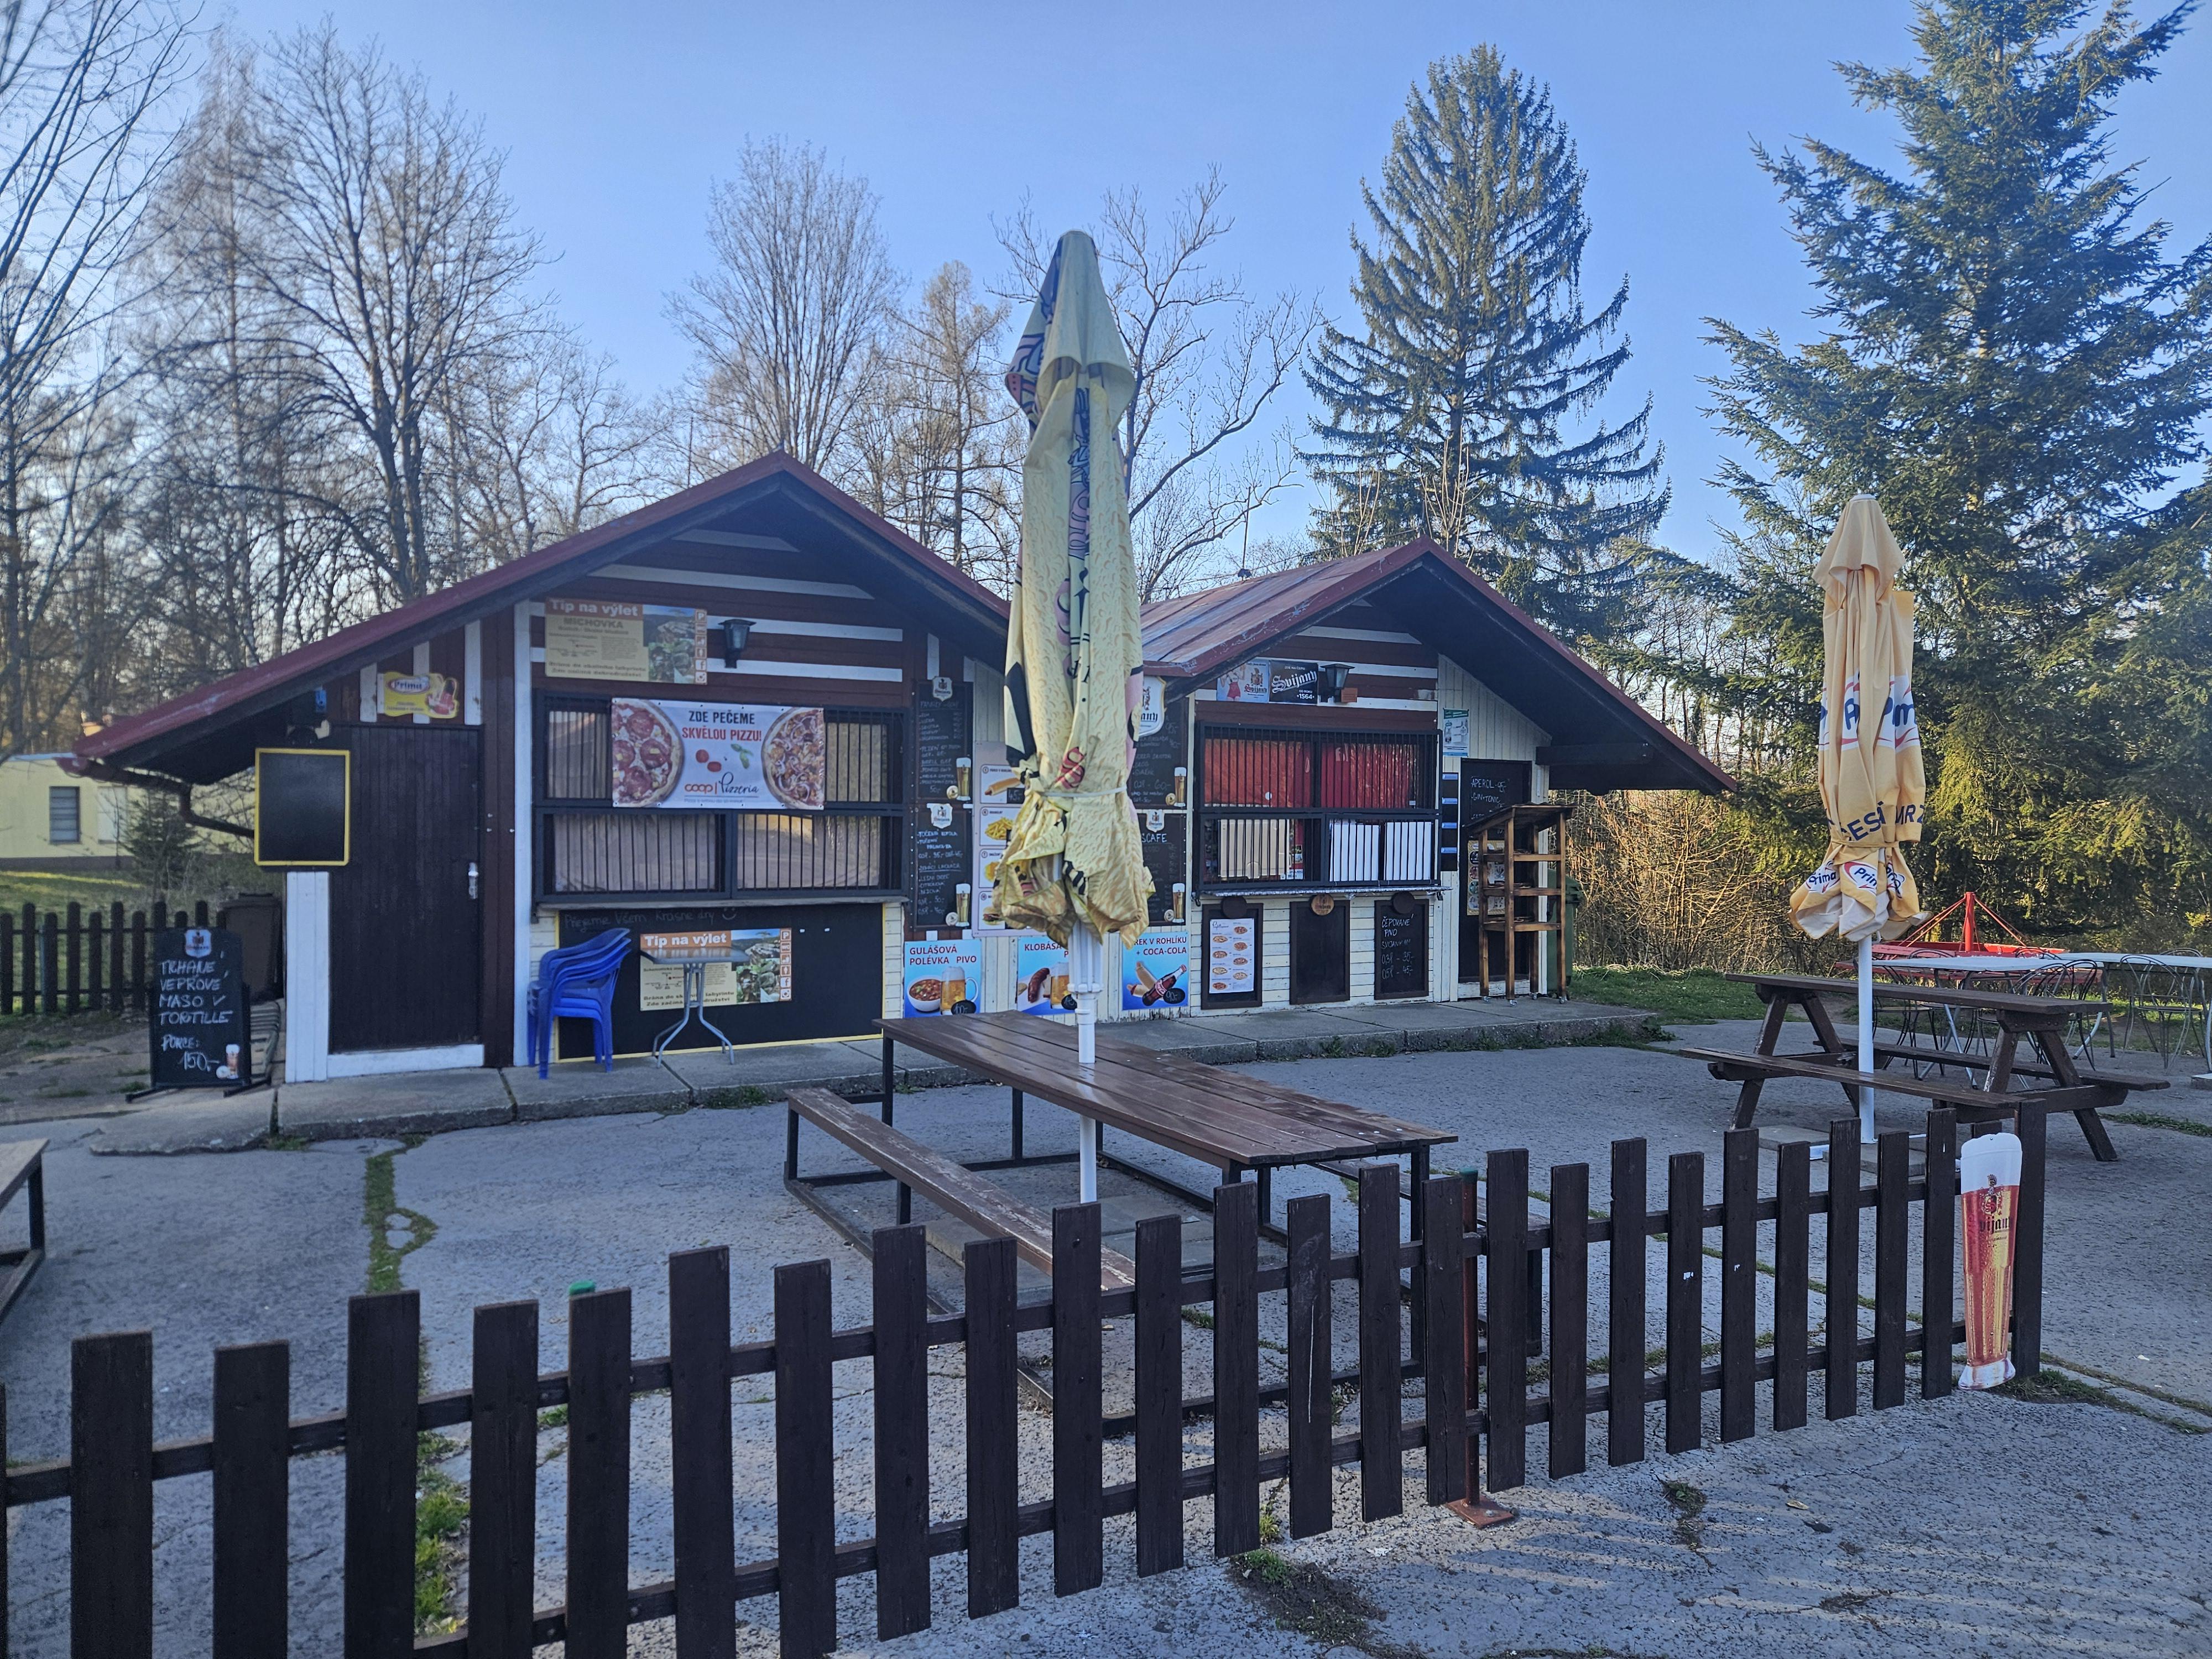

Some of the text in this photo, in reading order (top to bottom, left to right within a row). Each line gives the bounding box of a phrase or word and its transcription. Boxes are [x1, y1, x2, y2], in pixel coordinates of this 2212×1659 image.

[549, 599, 638, 617] Tip na výlet
[1271, 670, 1317, 693] Svijany
[688, 709, 755, 724] ZDE PEČEME
[682, 726, 762, 742] SKVĚLOU PIZZU!
[684, 771, 760, 795] coop Pizzeria
[1471, 778, 1495, 789] APEROL
[1847, 800, 1886, 841] ESÍ
[1141, 832, 1168, 843] SCAFE
[644, 933, 727, 948] Tip na výlet
[1156, 935, 1187, 945] ROHLÍKU
[910, 943, 957, 955] GULÁŠOVÁ
[1143, 947, 1187, 956] COCA-COLA
[909, 955, 977, 966] POLÉVKA PIVO
[159, 994, 205, 1008] MASO
[158, 1009, 234, 1026] TORTILLE
